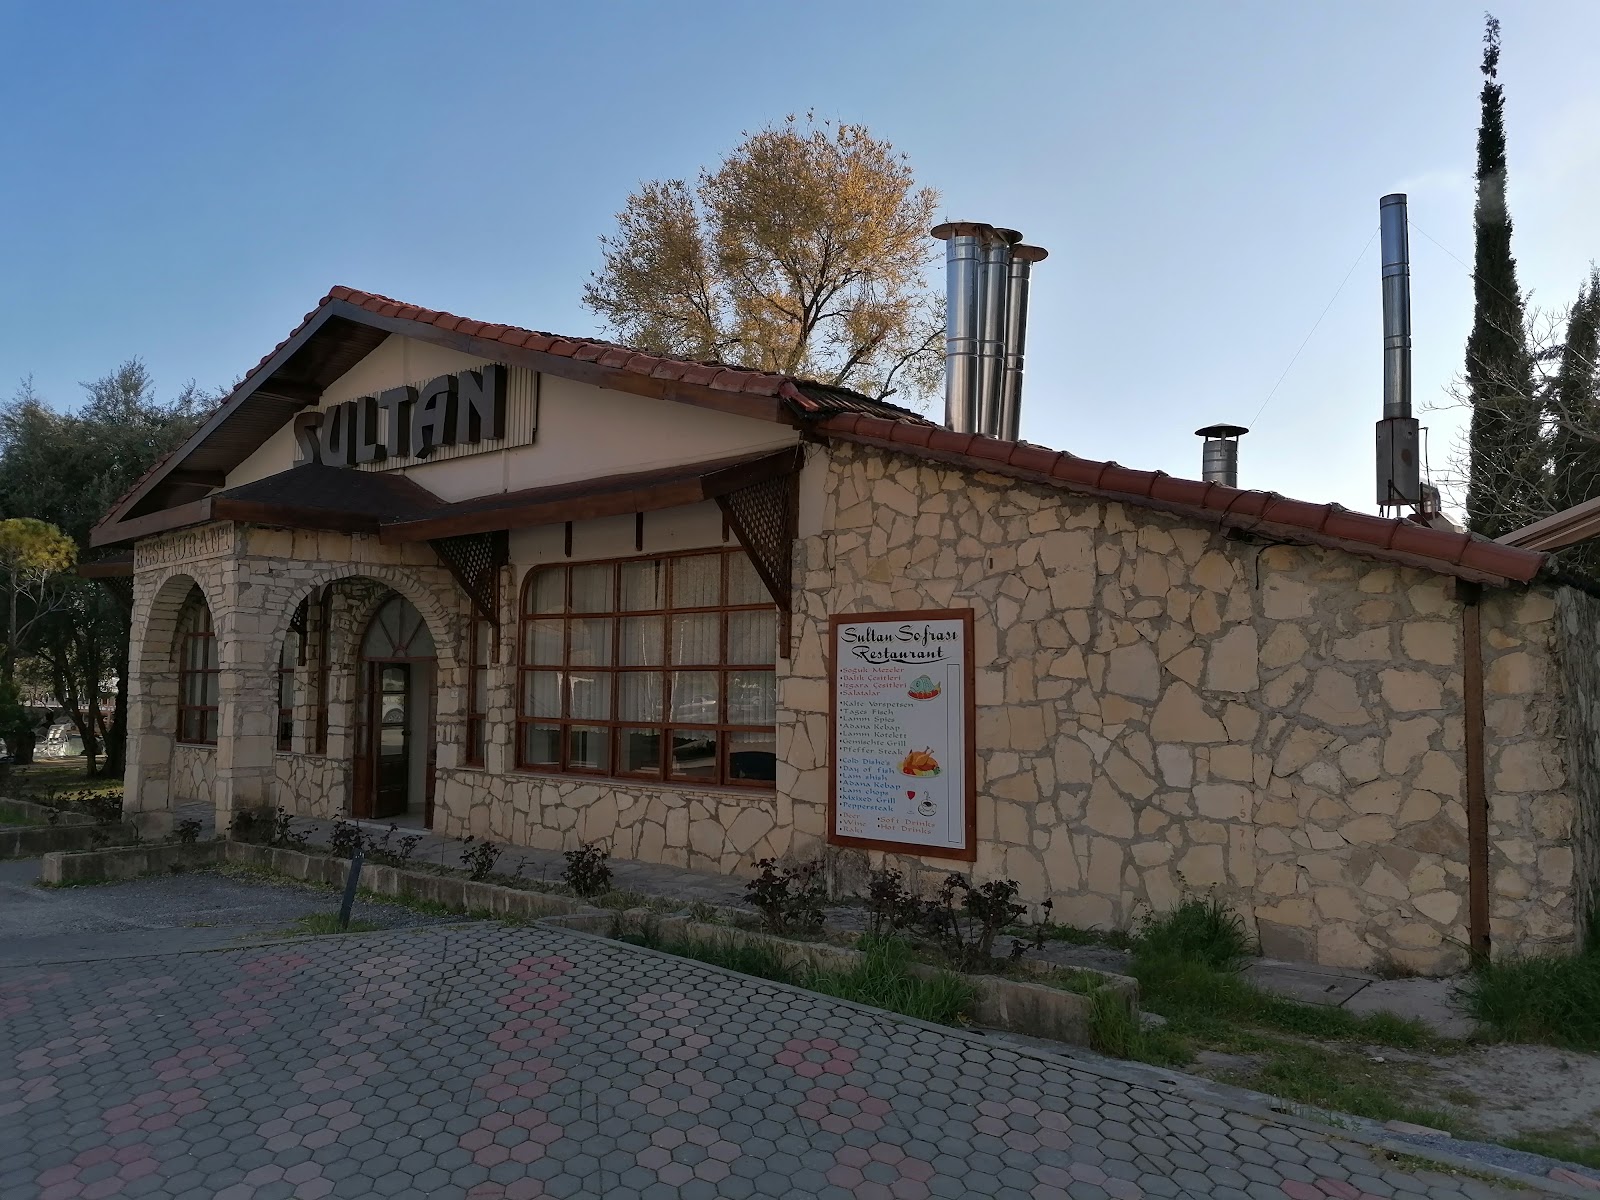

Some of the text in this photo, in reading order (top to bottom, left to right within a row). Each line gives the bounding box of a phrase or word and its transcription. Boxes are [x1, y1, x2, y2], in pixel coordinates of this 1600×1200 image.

[294, 363, 507, 467] SULTAN
[135, 523, 232, 569] RESTAURANT
[841, 627, 893, 642] Sultan
[851, 645, 949, 664] Restaurant
[874, 724, 900, 732] Kebap
[874, 782, 901, 791] Kebap
[880, 816, 935, 828] Soft Drinks
[901, 825, 931, 834] Drinks
